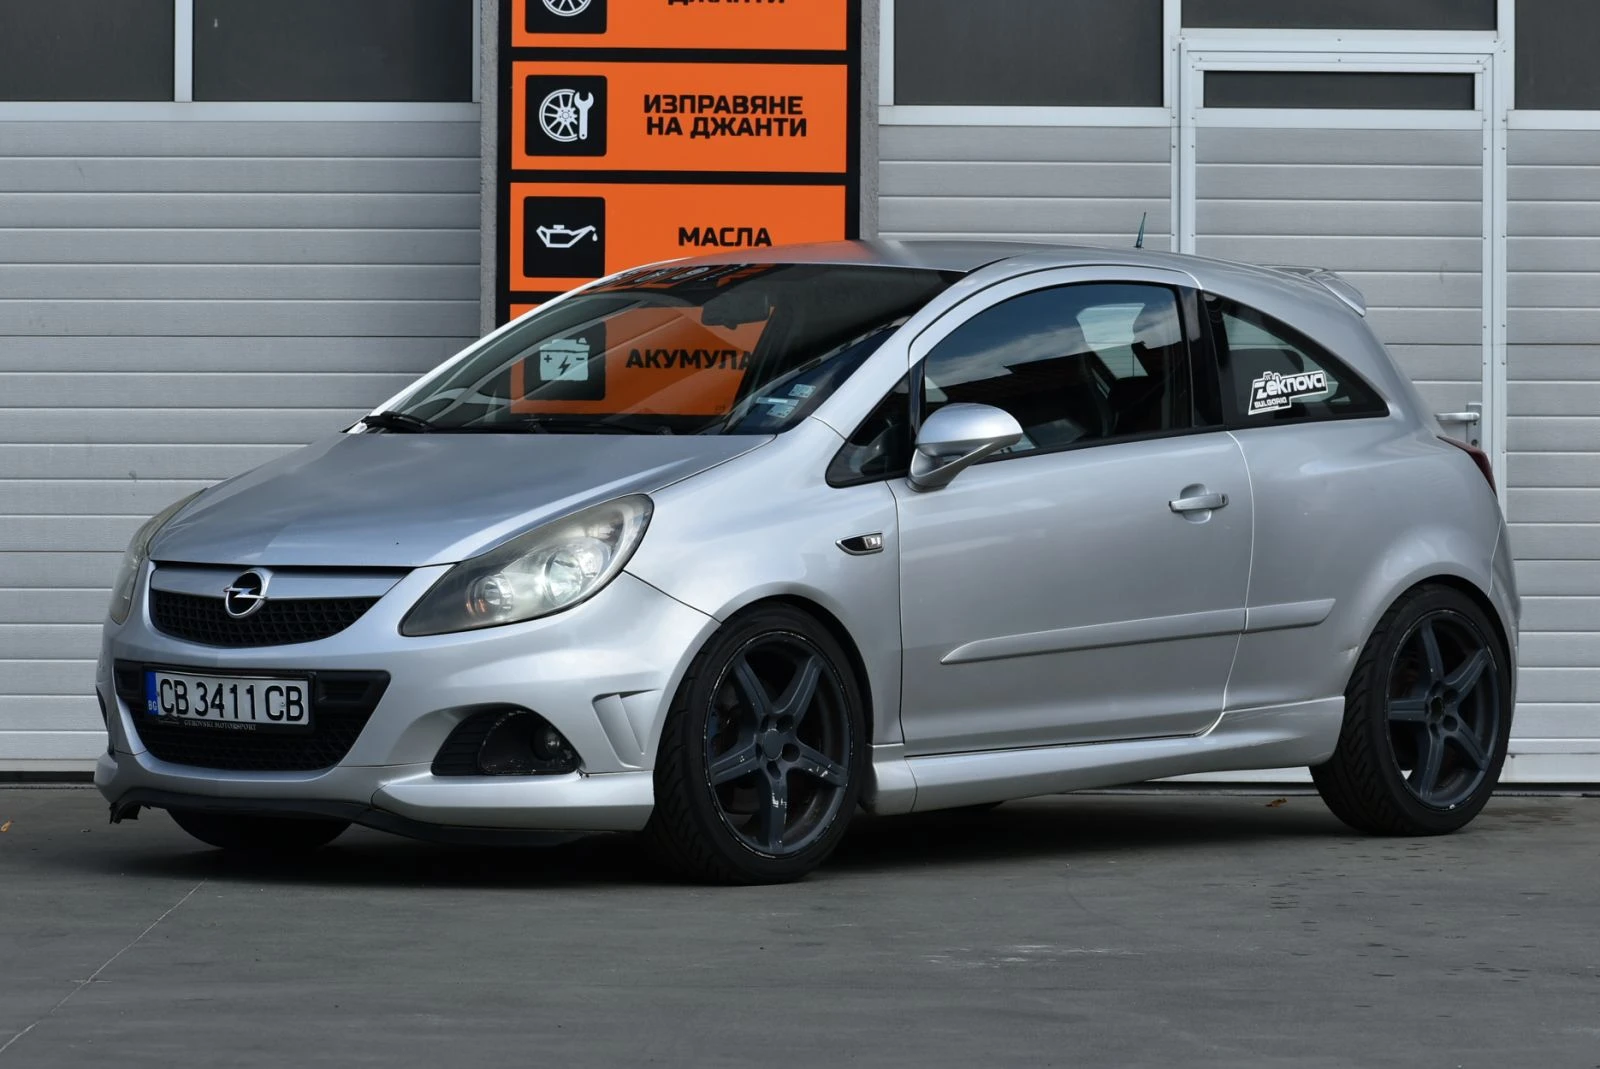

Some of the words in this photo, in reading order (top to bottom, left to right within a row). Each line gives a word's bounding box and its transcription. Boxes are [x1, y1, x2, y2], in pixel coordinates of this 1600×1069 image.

[643, 94, 804, 116] ИЗПРАВЯНЕ
[646, 116, 683, 137] НА
[689, 117, 807, 139] ДЖАНТИ
[678, 227, 773, 247] МАСЛА
[1254, 373, 1325, 399] Zeknova
[147, 699, 159, 711] BG
[159, 678, 190, 716] CB
[194, 681, 257, 720] 3411
[264, 685, 305, 722] CB
